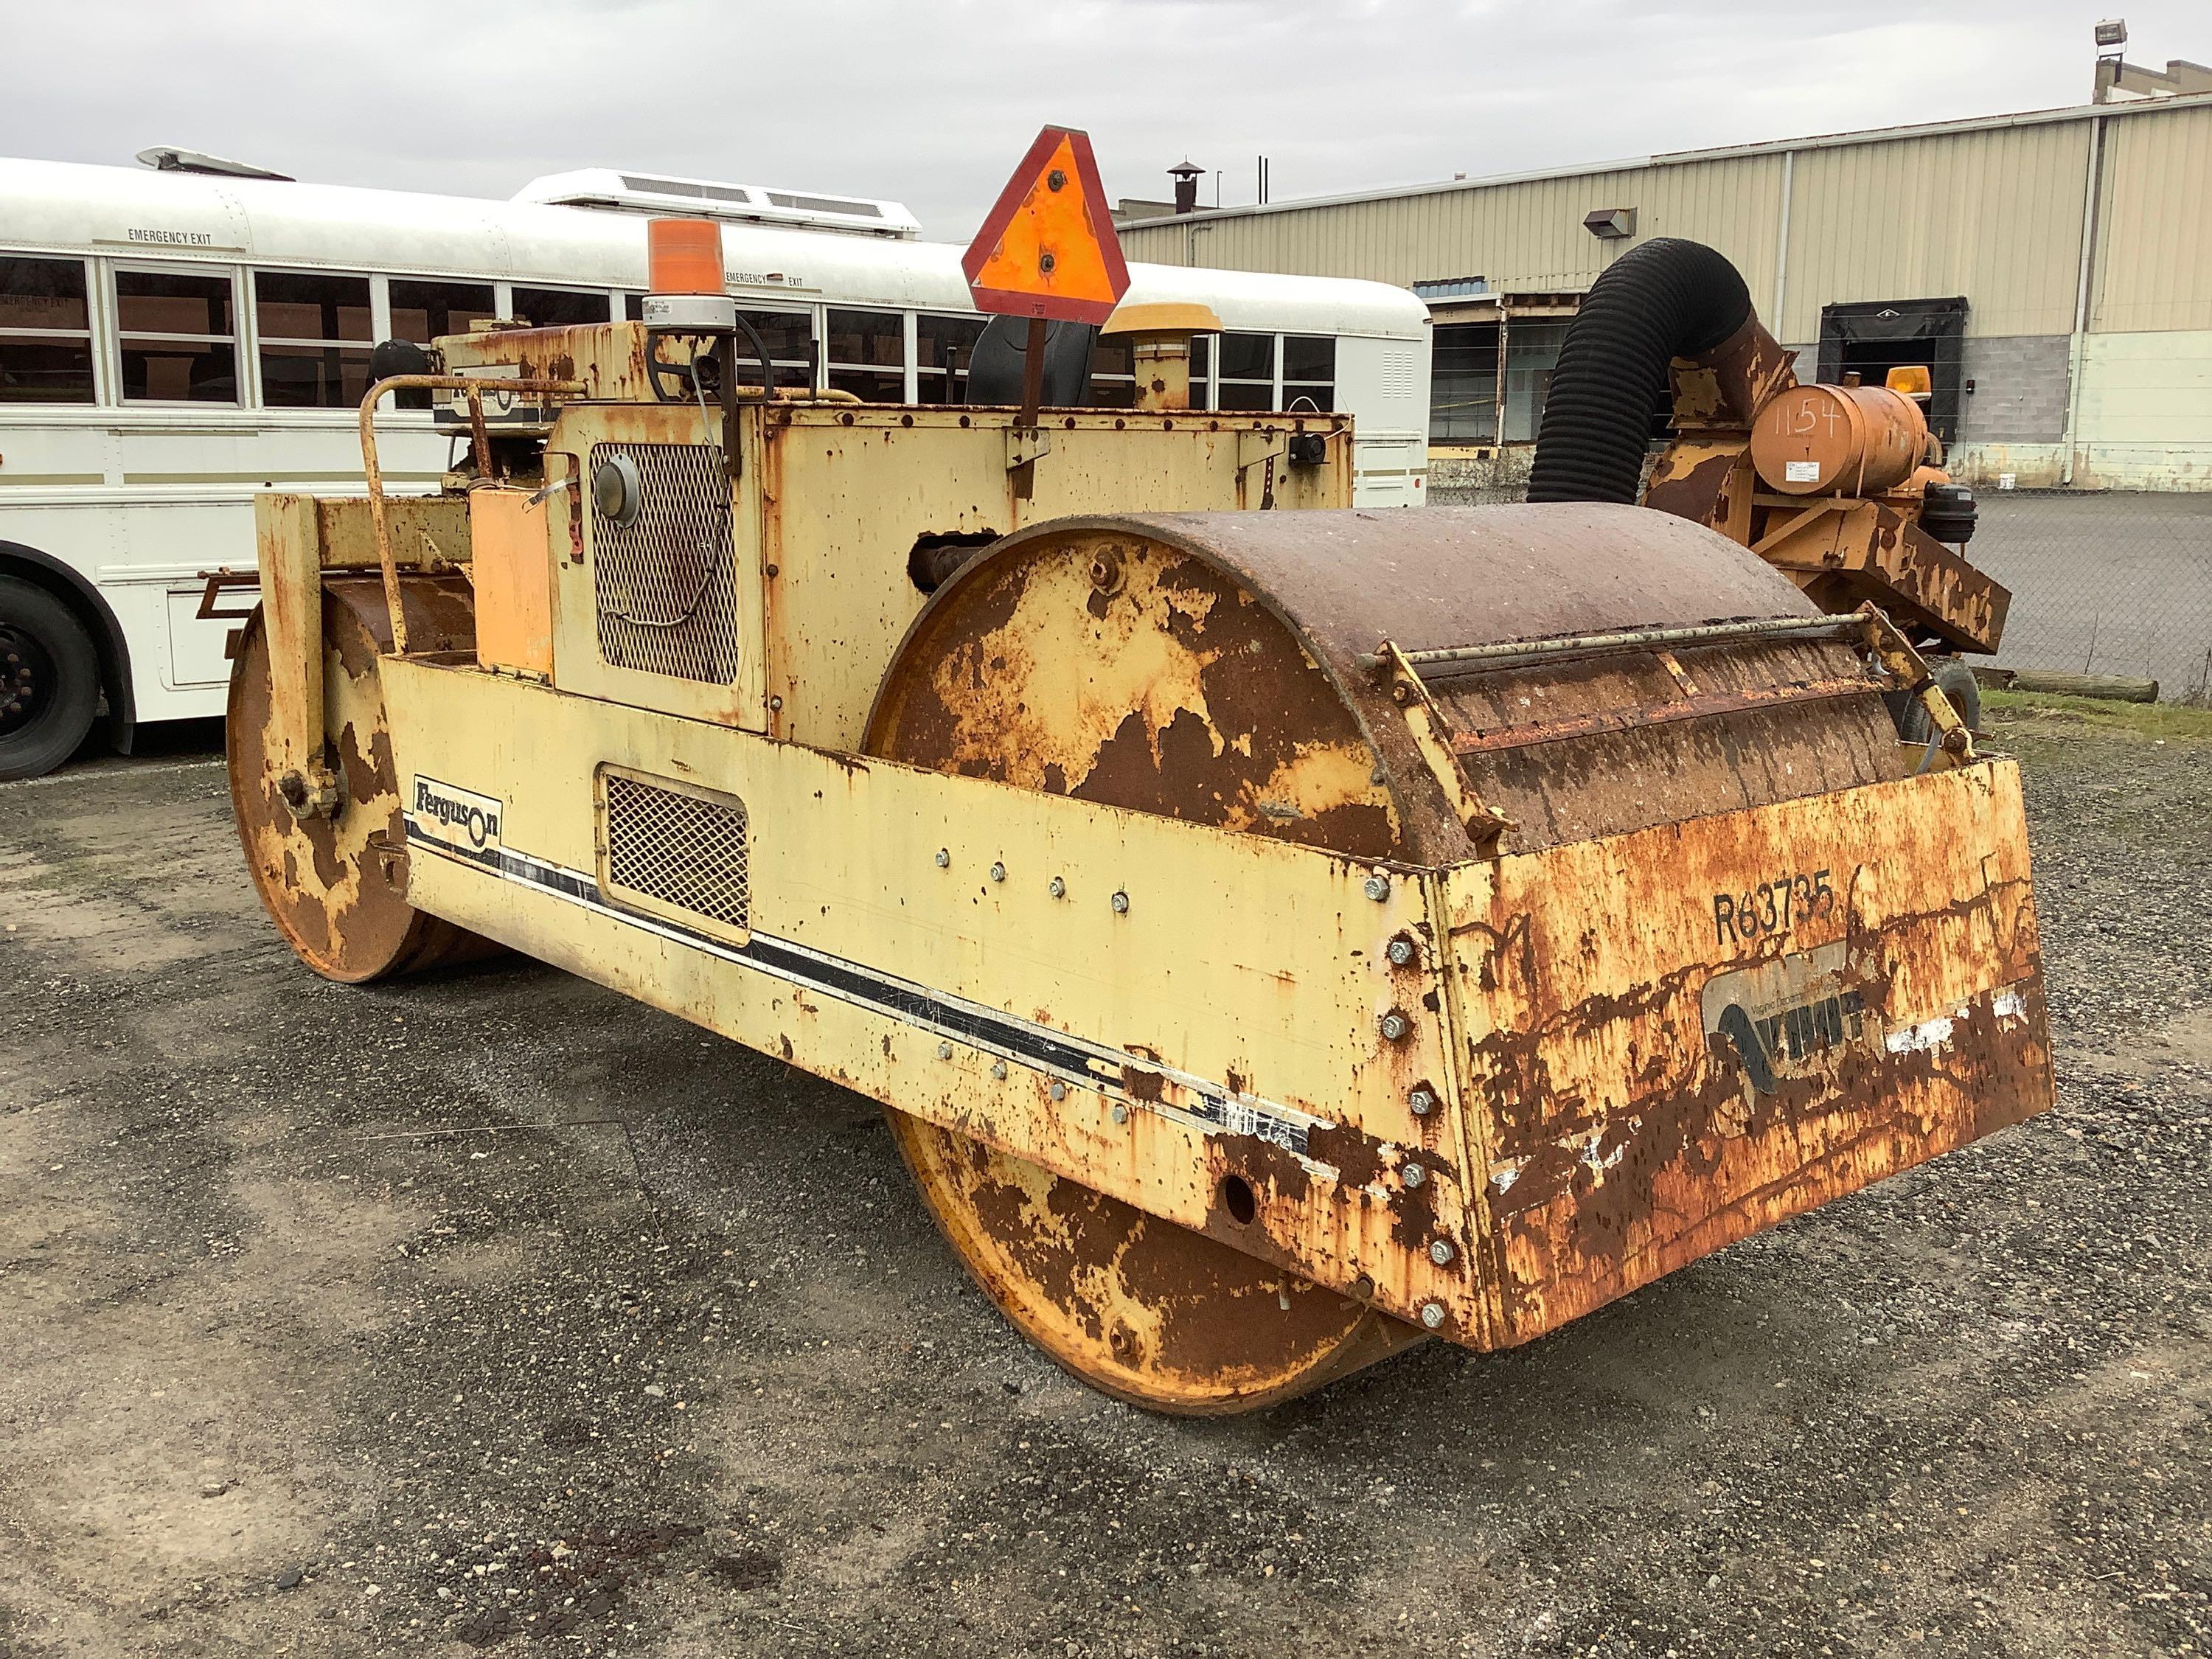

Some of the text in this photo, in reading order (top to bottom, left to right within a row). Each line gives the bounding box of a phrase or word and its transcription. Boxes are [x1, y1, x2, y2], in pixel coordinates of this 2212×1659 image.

[128, 229, 212, 245] EMERGENCY EXIT
[726, 272, 802, 287] EMERGENCY EXIT
[1775, 398, 1841, 439] 1154
[1714, 869, 1834, 945] R63735
